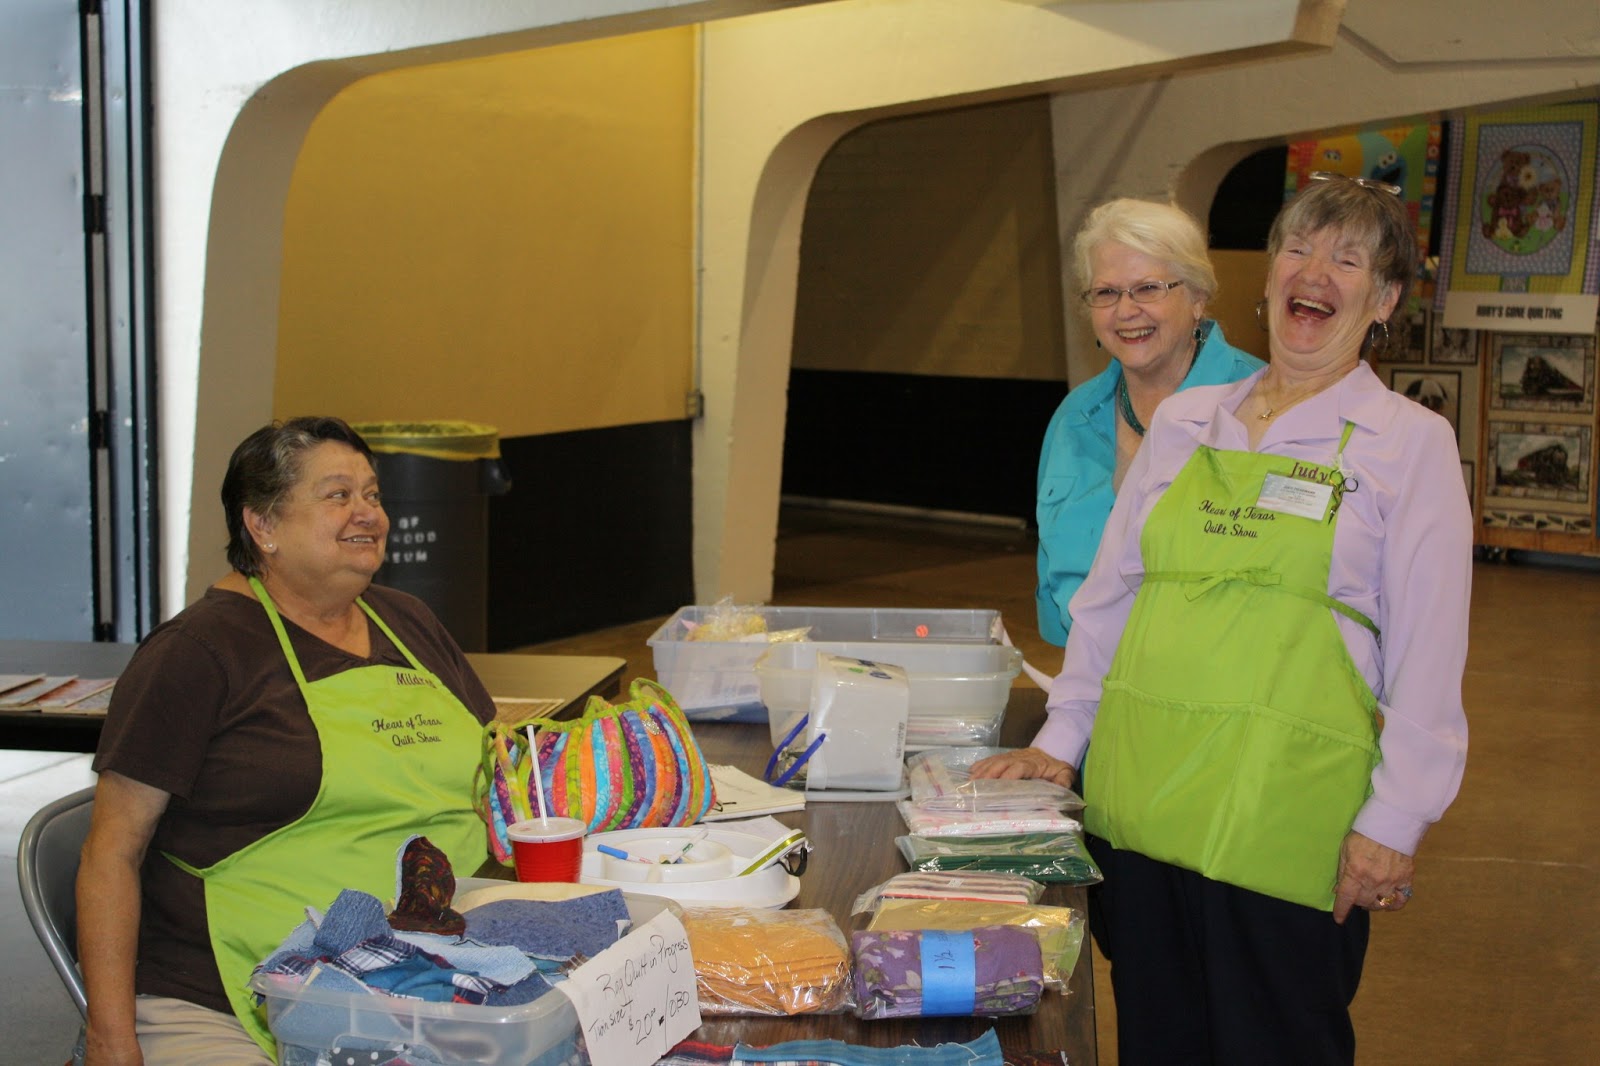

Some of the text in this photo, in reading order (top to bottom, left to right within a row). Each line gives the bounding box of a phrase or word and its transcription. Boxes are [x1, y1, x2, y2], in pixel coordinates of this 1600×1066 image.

[1527, 307, 1563, 321] QUILTING
[1288, 462, 1328, 484] Judy
[1229, 507, 1242, 521] of
[1243, 506, 1276, 521] Texas
[1203, 520, 1258, 538] Quilt Show
[371, 713, 442, 733] Heart of Texas
[391, 731, 442, 747] Quilt Show
[596, 934, 689, 1002] Rag Quilt in Progress
